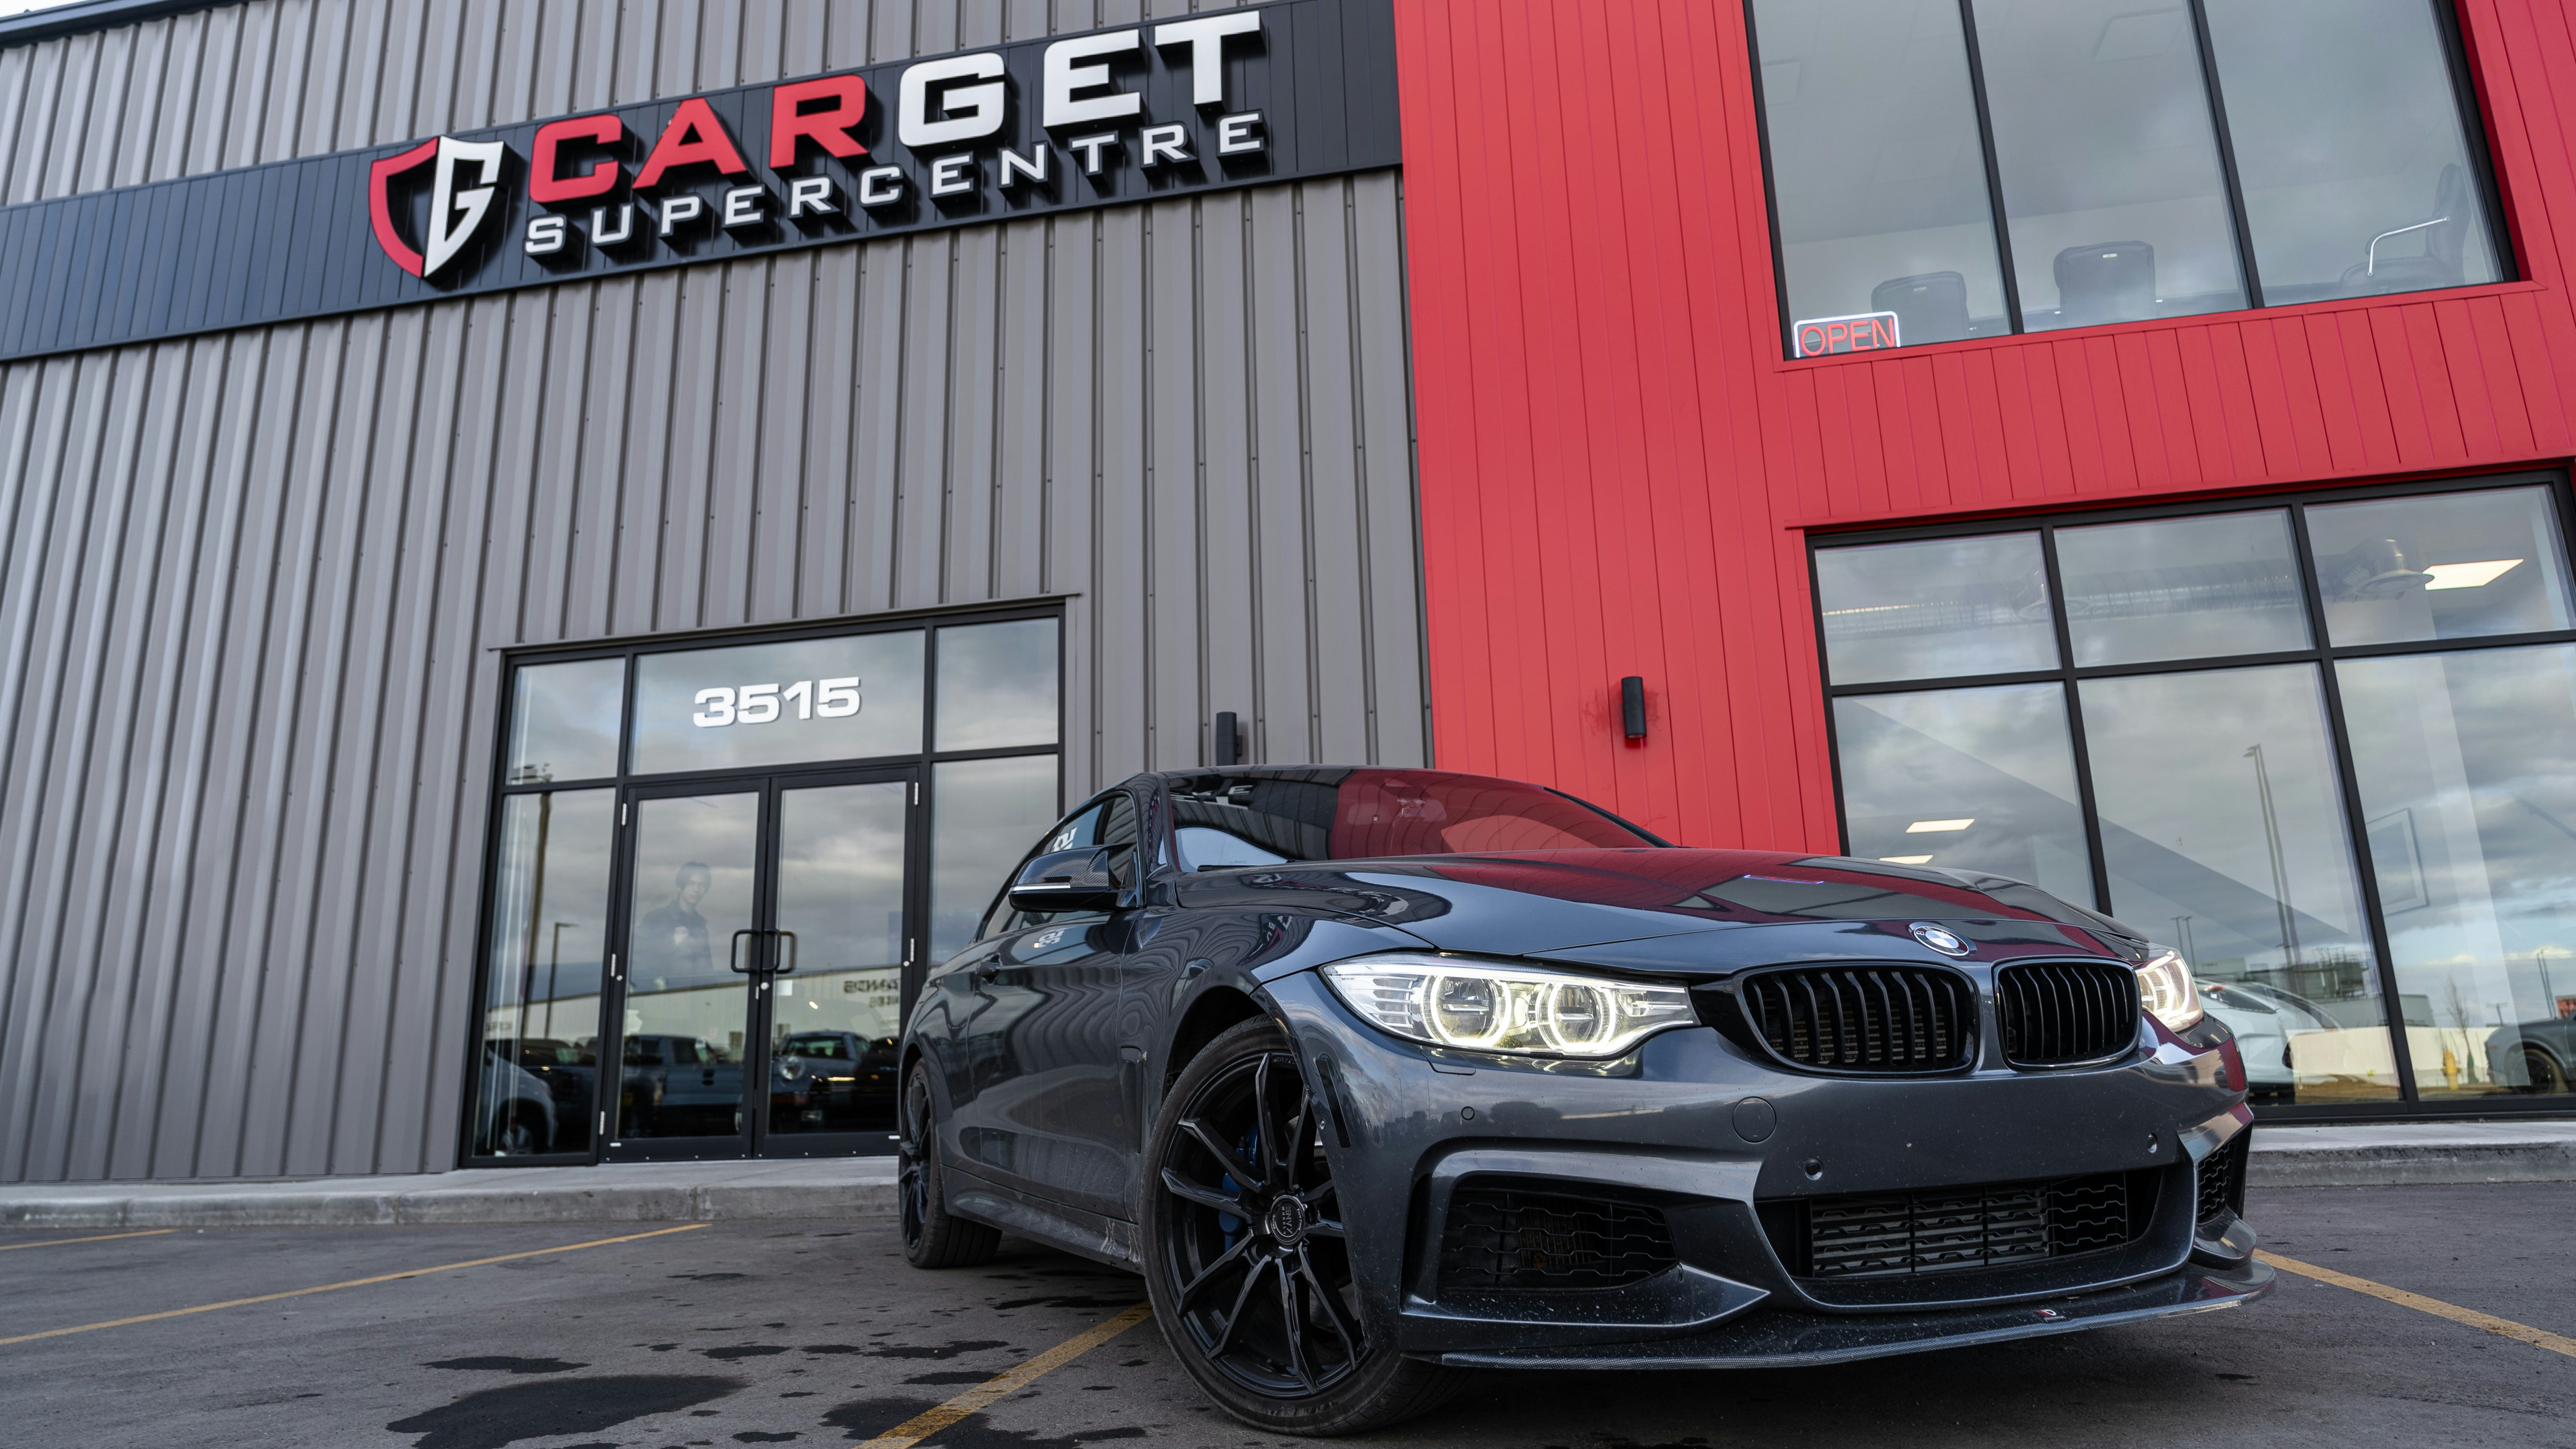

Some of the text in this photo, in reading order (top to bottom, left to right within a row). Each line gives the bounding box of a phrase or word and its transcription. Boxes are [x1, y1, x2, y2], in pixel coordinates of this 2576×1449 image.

[525, 112, 1261, 254] SUPERCENTRE
[1800, 318, 1895, 356] OPEN
[693, 676, 860, 727] 3515
